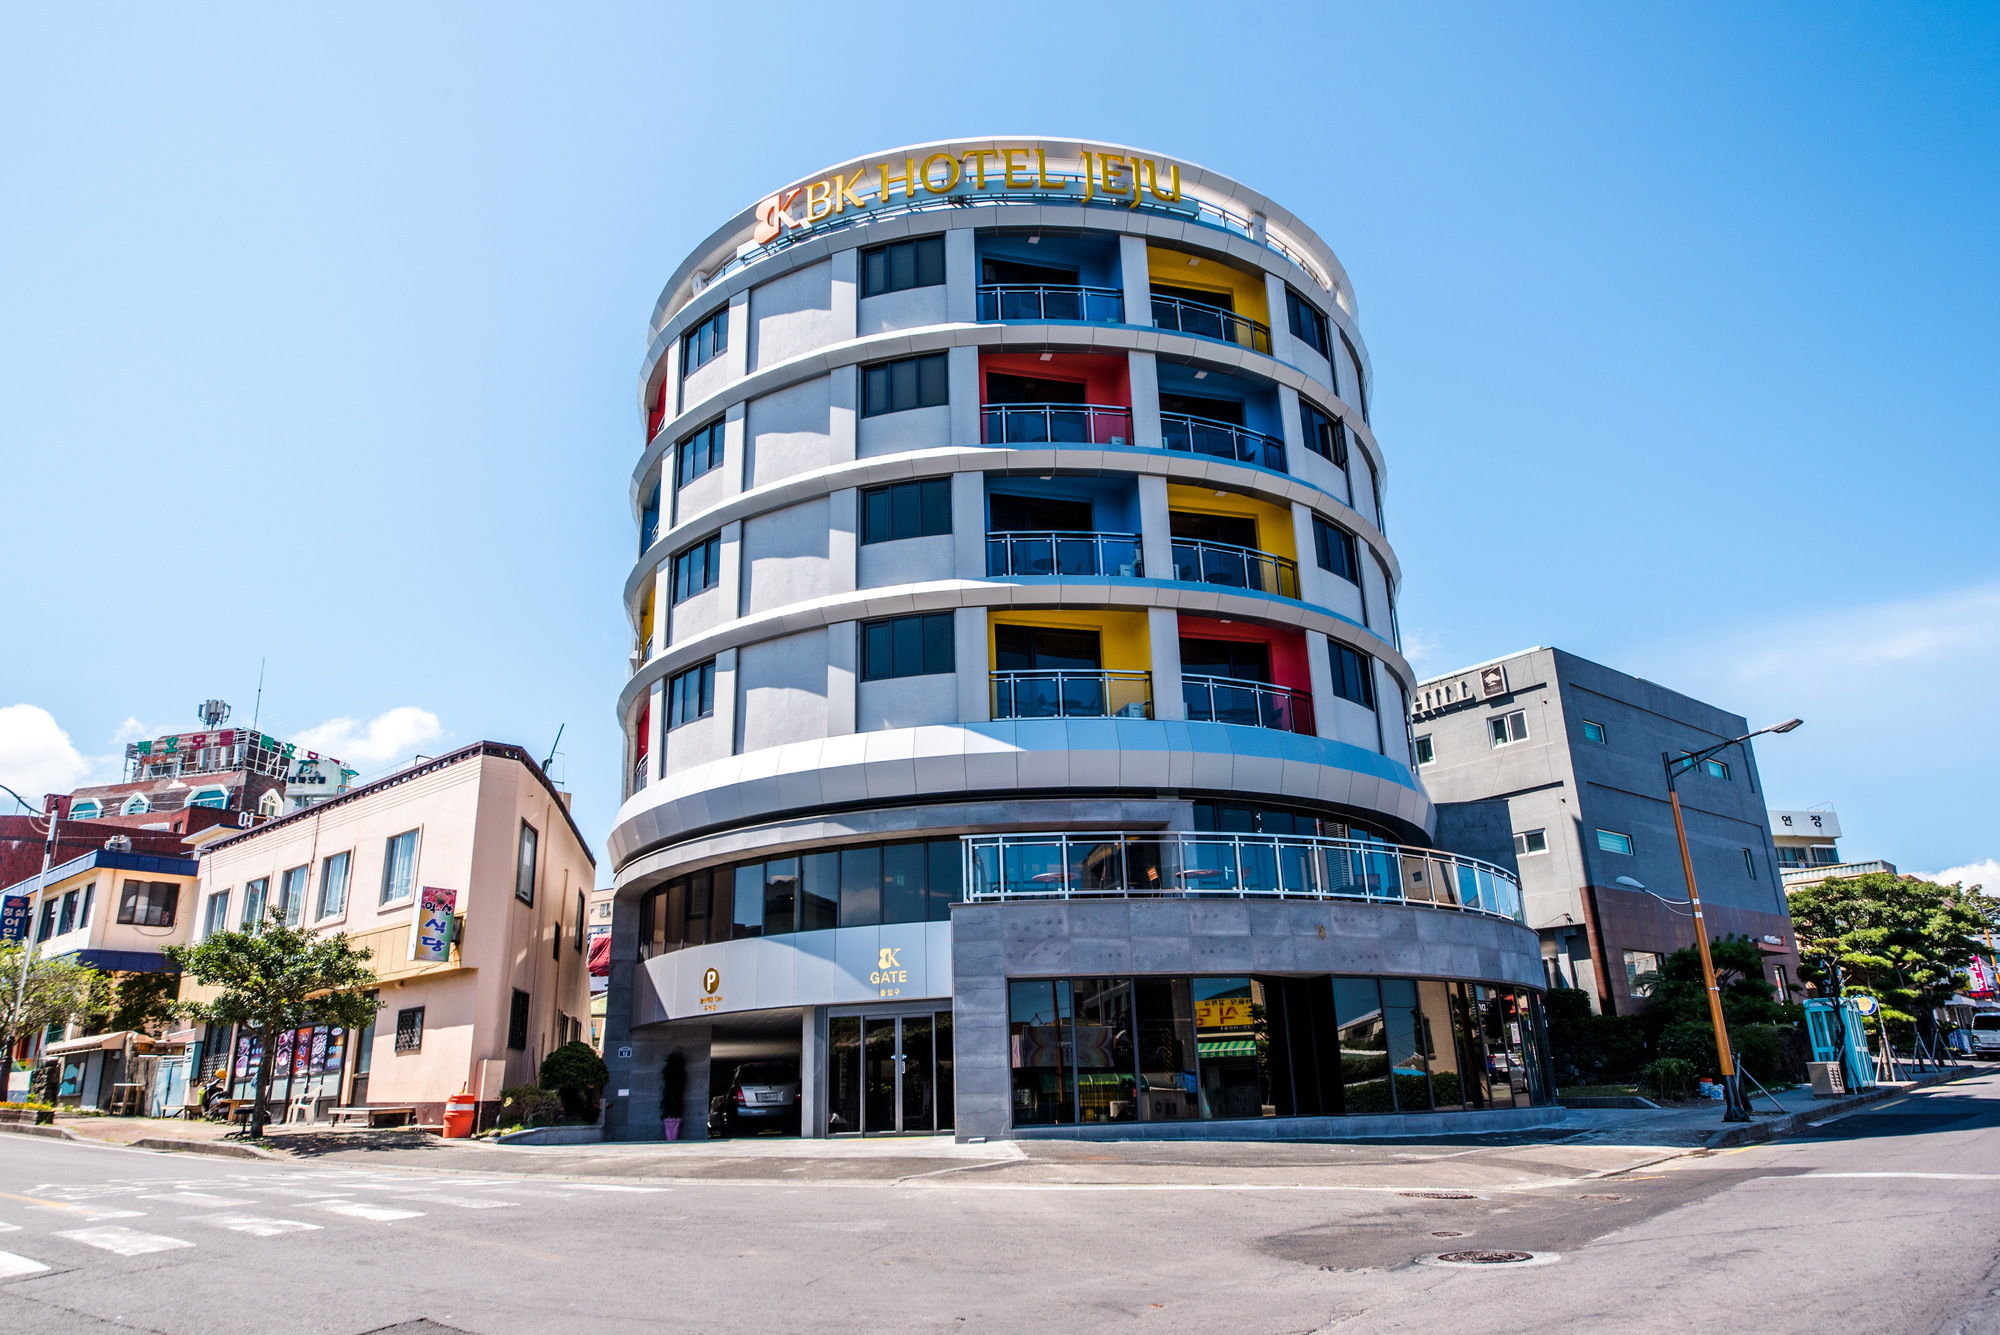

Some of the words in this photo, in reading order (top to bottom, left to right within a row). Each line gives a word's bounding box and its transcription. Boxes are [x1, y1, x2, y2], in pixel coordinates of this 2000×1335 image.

[804, 168, 865, 223] BK
[876, 148, 1066, 202] HOTEL
[1081, 150, 1181, 208] JEJU
[421, 918, 447, 952] 식당
[870, 970, 908, 984] GATE
